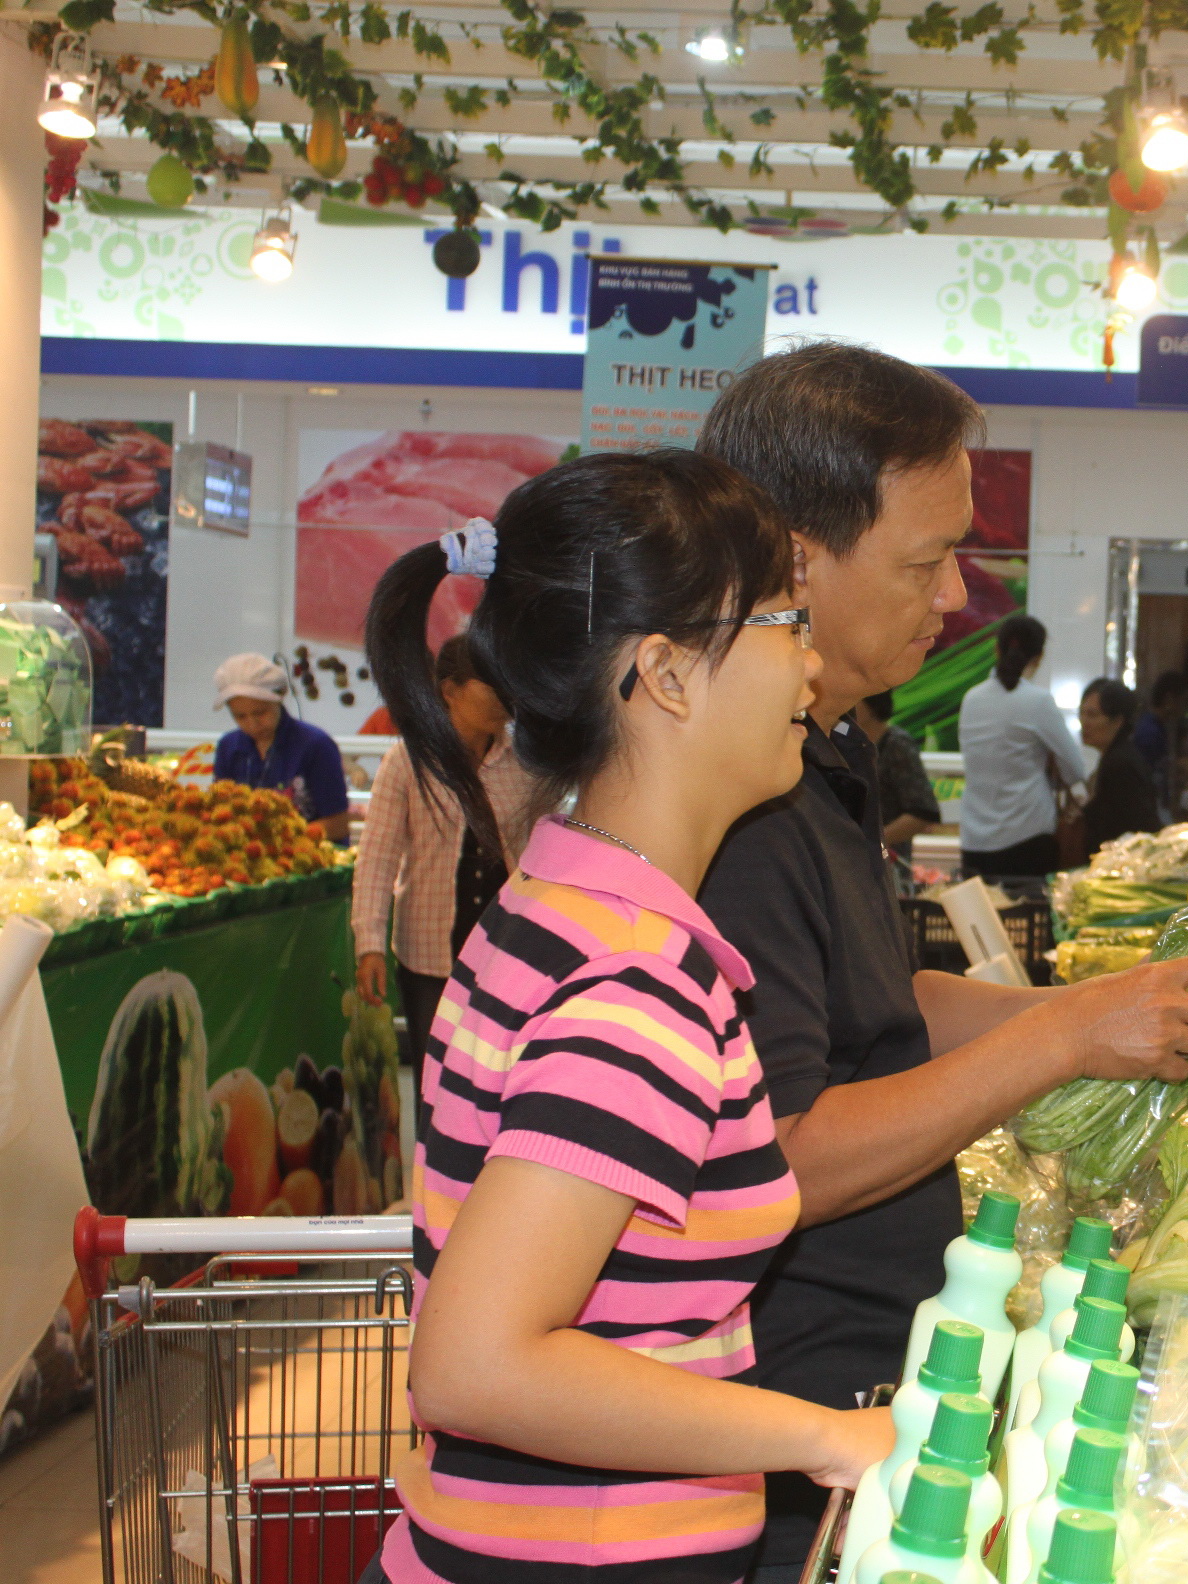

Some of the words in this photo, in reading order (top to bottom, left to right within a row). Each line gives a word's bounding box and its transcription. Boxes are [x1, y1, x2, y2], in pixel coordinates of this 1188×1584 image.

[424, 228, 621, 335] Thị
[611, 363, 673, 393] THỊT
[678, 367, 735, 392] HEO
